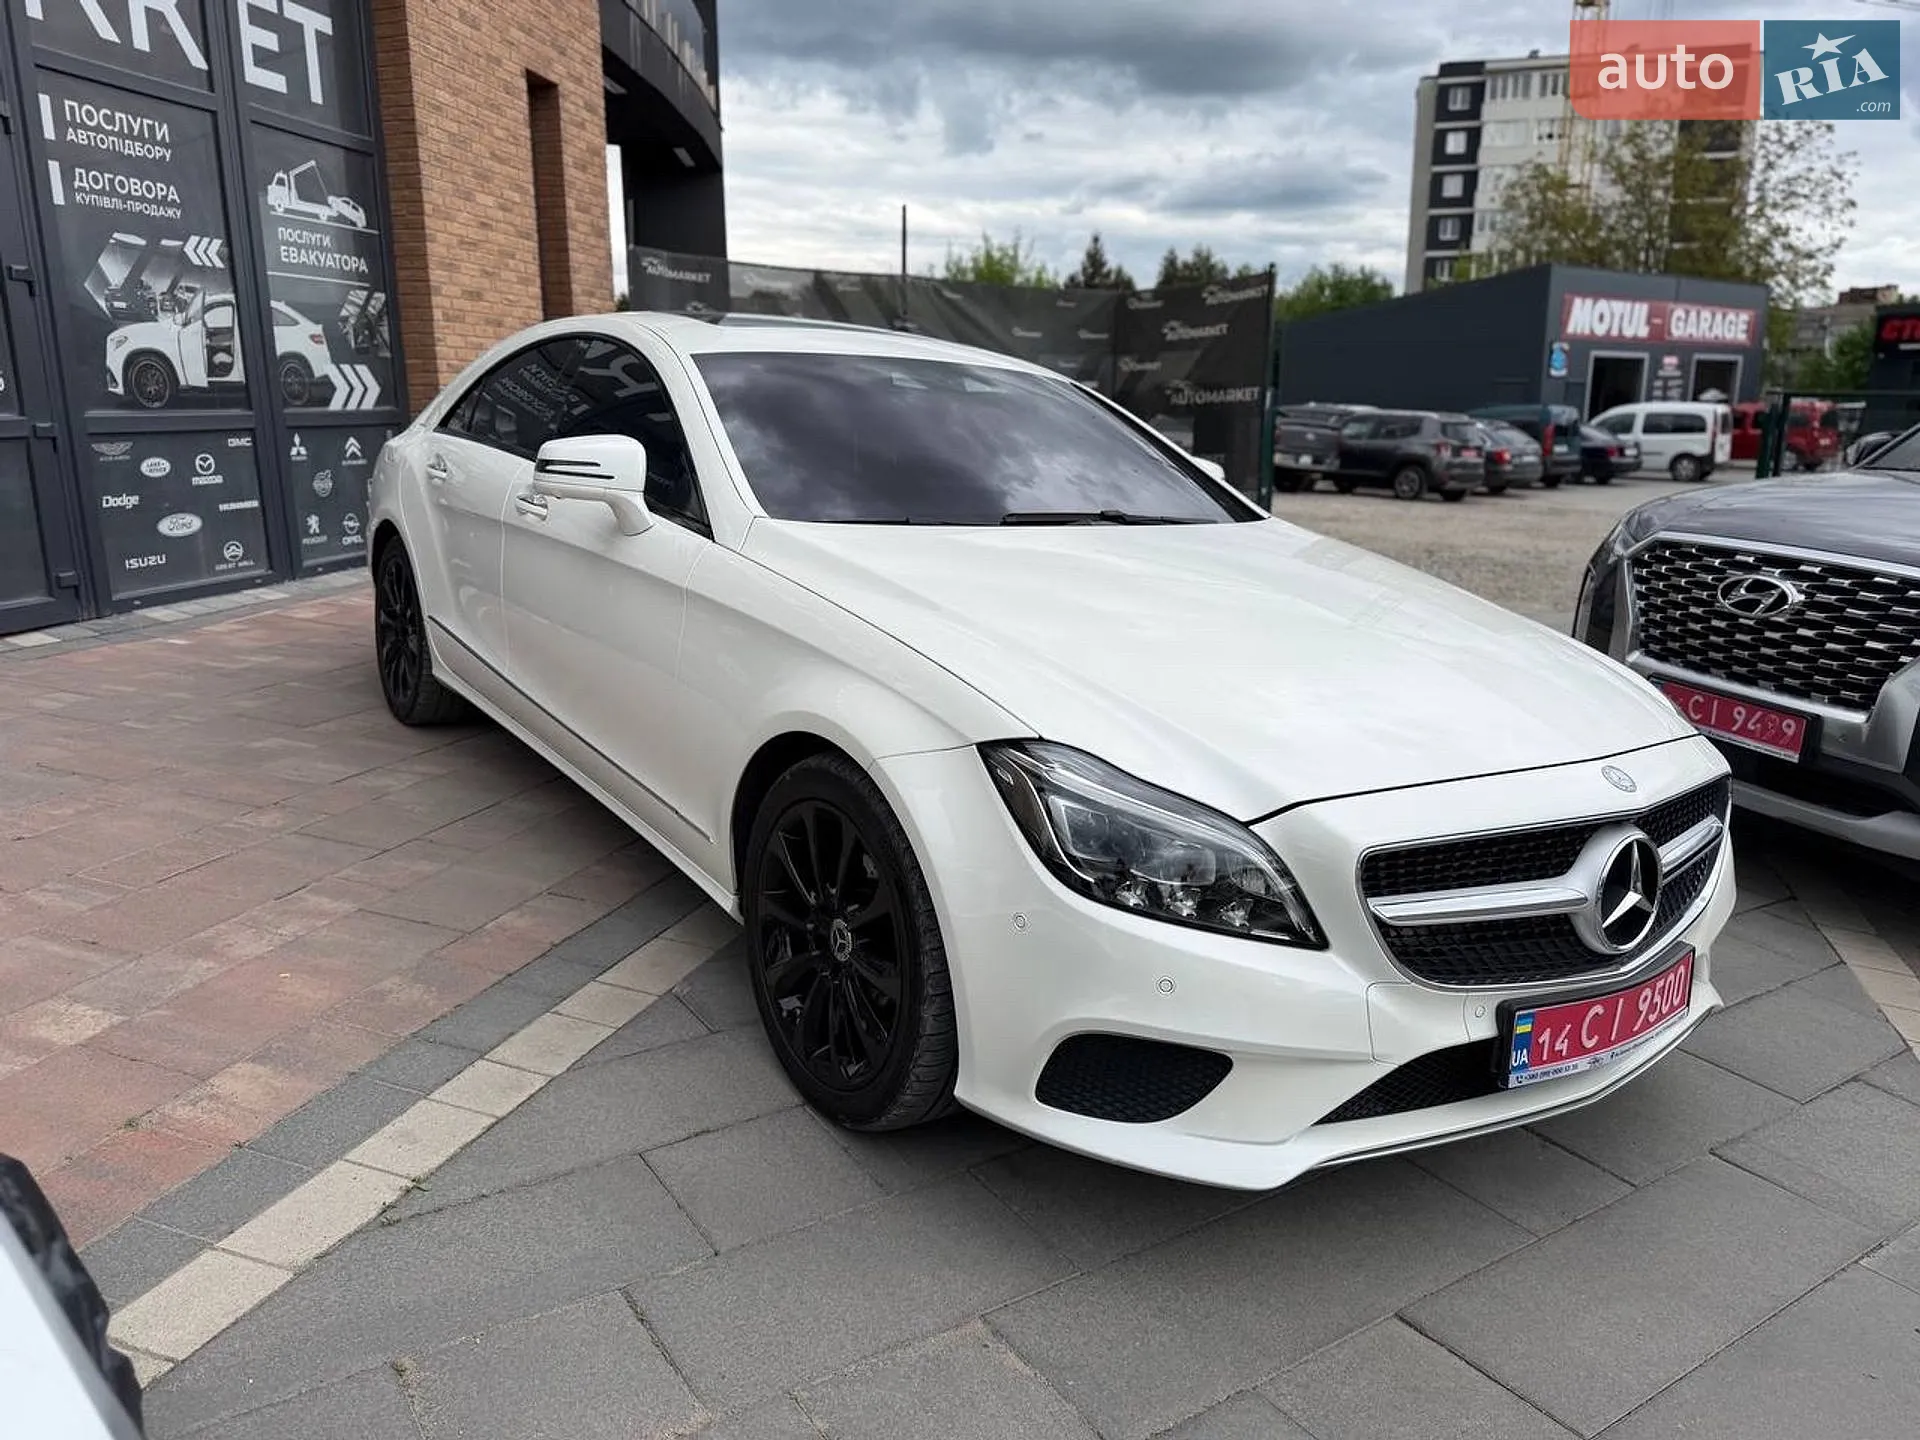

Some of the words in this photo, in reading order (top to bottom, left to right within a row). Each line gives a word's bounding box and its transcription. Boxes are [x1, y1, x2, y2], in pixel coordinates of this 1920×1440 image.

[63, 98, 170, 143] ПОСЛУГИ
[66, 127, 172, 162] АВТОПІДБОРУ
[74, 167, 181, 204] ДОГОВОРА
[75, 192, 182, 220] КУПІВЛІ-ПРОДАЖУ
[278, 227, 332, 248] ПОСЛУГИ
[280, 245, 369, 275] ЕВАКУАТОРА
[1566, 296, 1650, 338] MOTUL
[1670, 307, 1750, 339] GARAGE
[1170, 386, 1260, 405] AUTOMARKET
[102, 493, 139, 509] Dodge
[125, 554, 166, 571] ISUZU
[1537, 1023, 1571, 1062] 14
[1580, 997, 1624, 1050] CI
[1632, 965, 1685, 1032] 9500
[1511, 1048, 1529, 1067] UA
